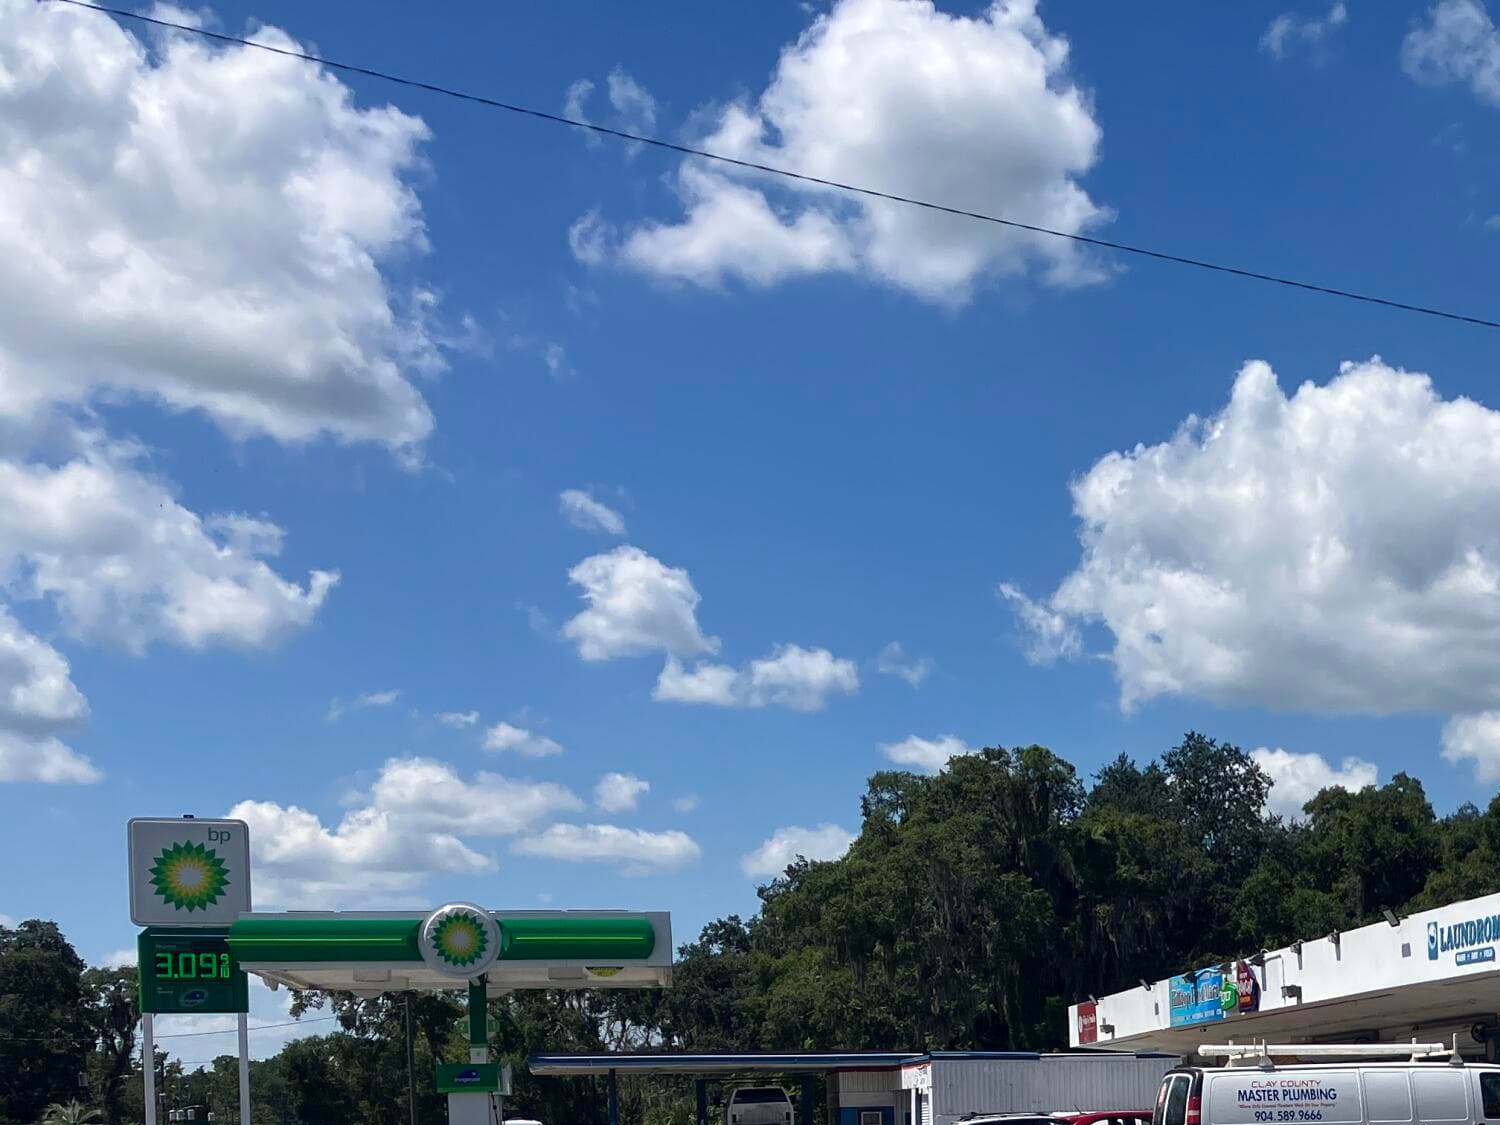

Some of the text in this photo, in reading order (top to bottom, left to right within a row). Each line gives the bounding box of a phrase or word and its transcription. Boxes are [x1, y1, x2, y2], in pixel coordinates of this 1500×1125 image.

[208, 827, 231, 844] bp
[156, 953, 217, 978] 3.09
[1280, 1080, 1322, 1088] COUNTY
[1238, 1088, 1337, 1101] MASTER PLUMBING
[1254, 1110, 1322, 1121] 904.589.9666
